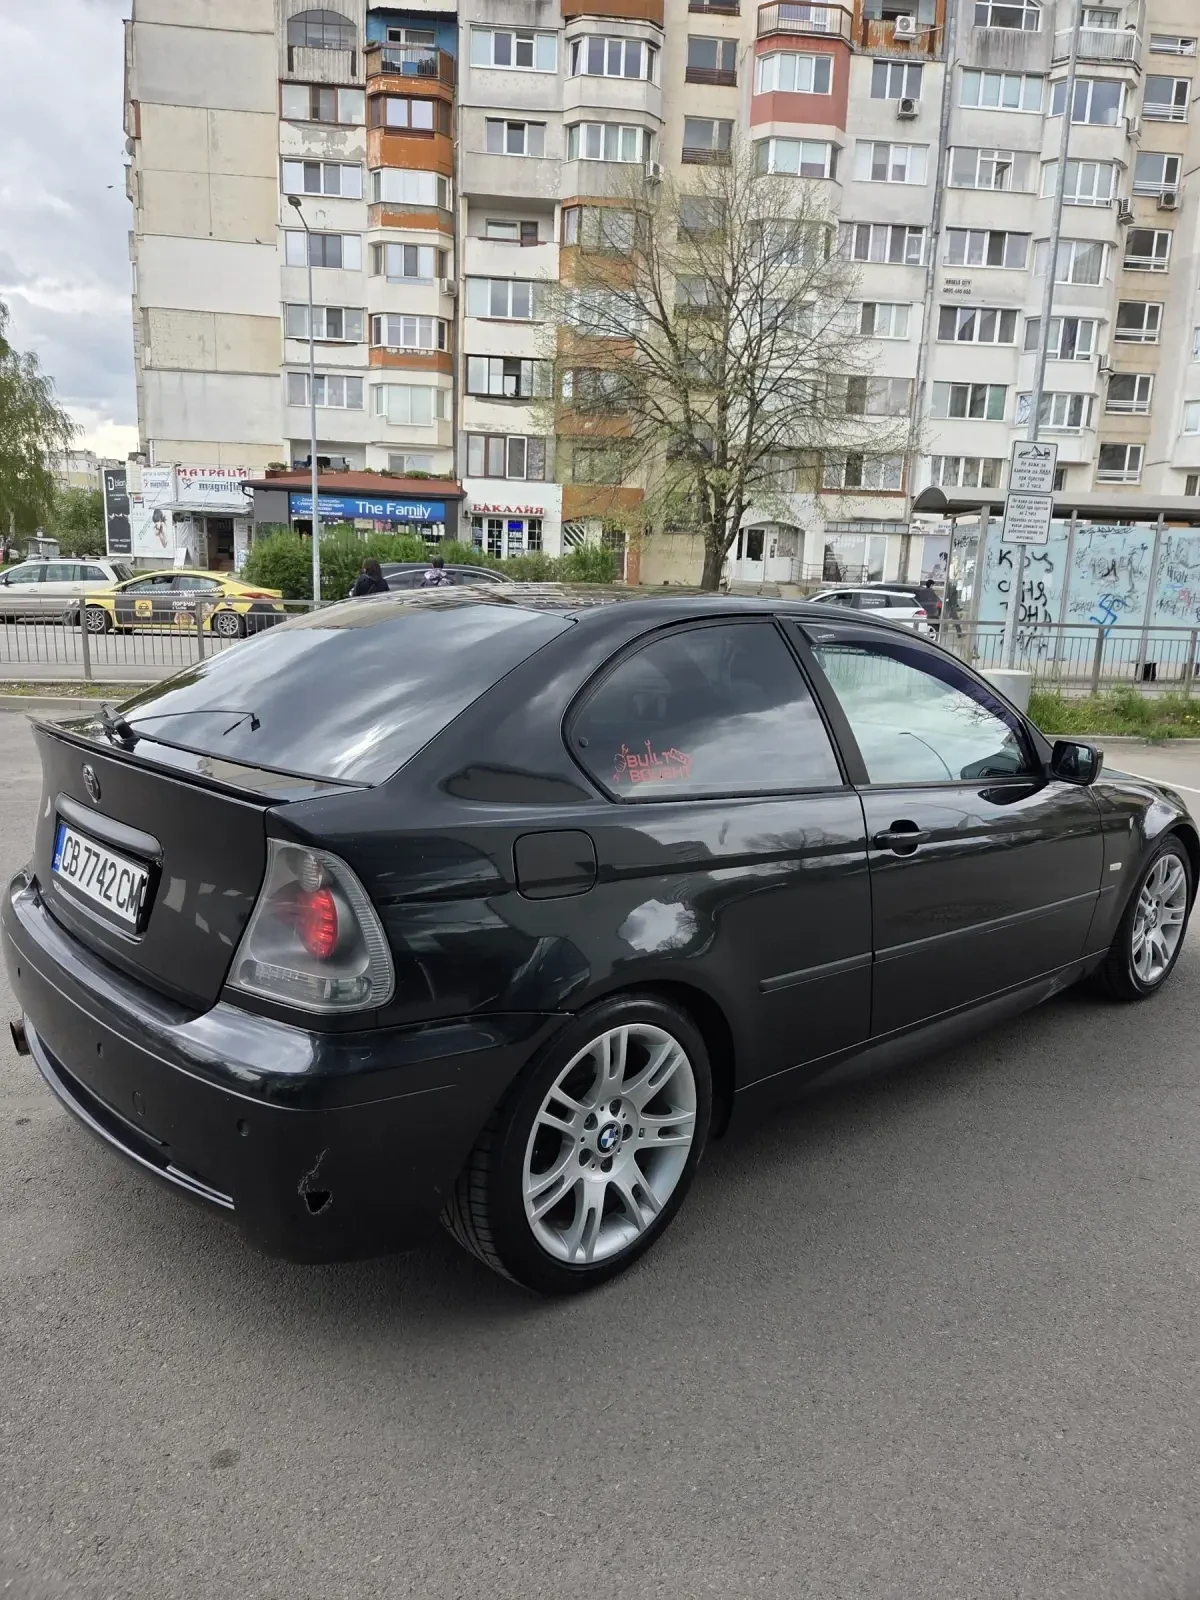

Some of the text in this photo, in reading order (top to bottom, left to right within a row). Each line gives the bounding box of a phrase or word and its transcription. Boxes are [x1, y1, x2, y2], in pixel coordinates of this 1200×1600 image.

[177, 468, 247, 478] МАТРАЦИ
[198, 482, 243, 492] magnifle
[355, 501, 383, 514] The
[386, 503, 432, 519] Family
